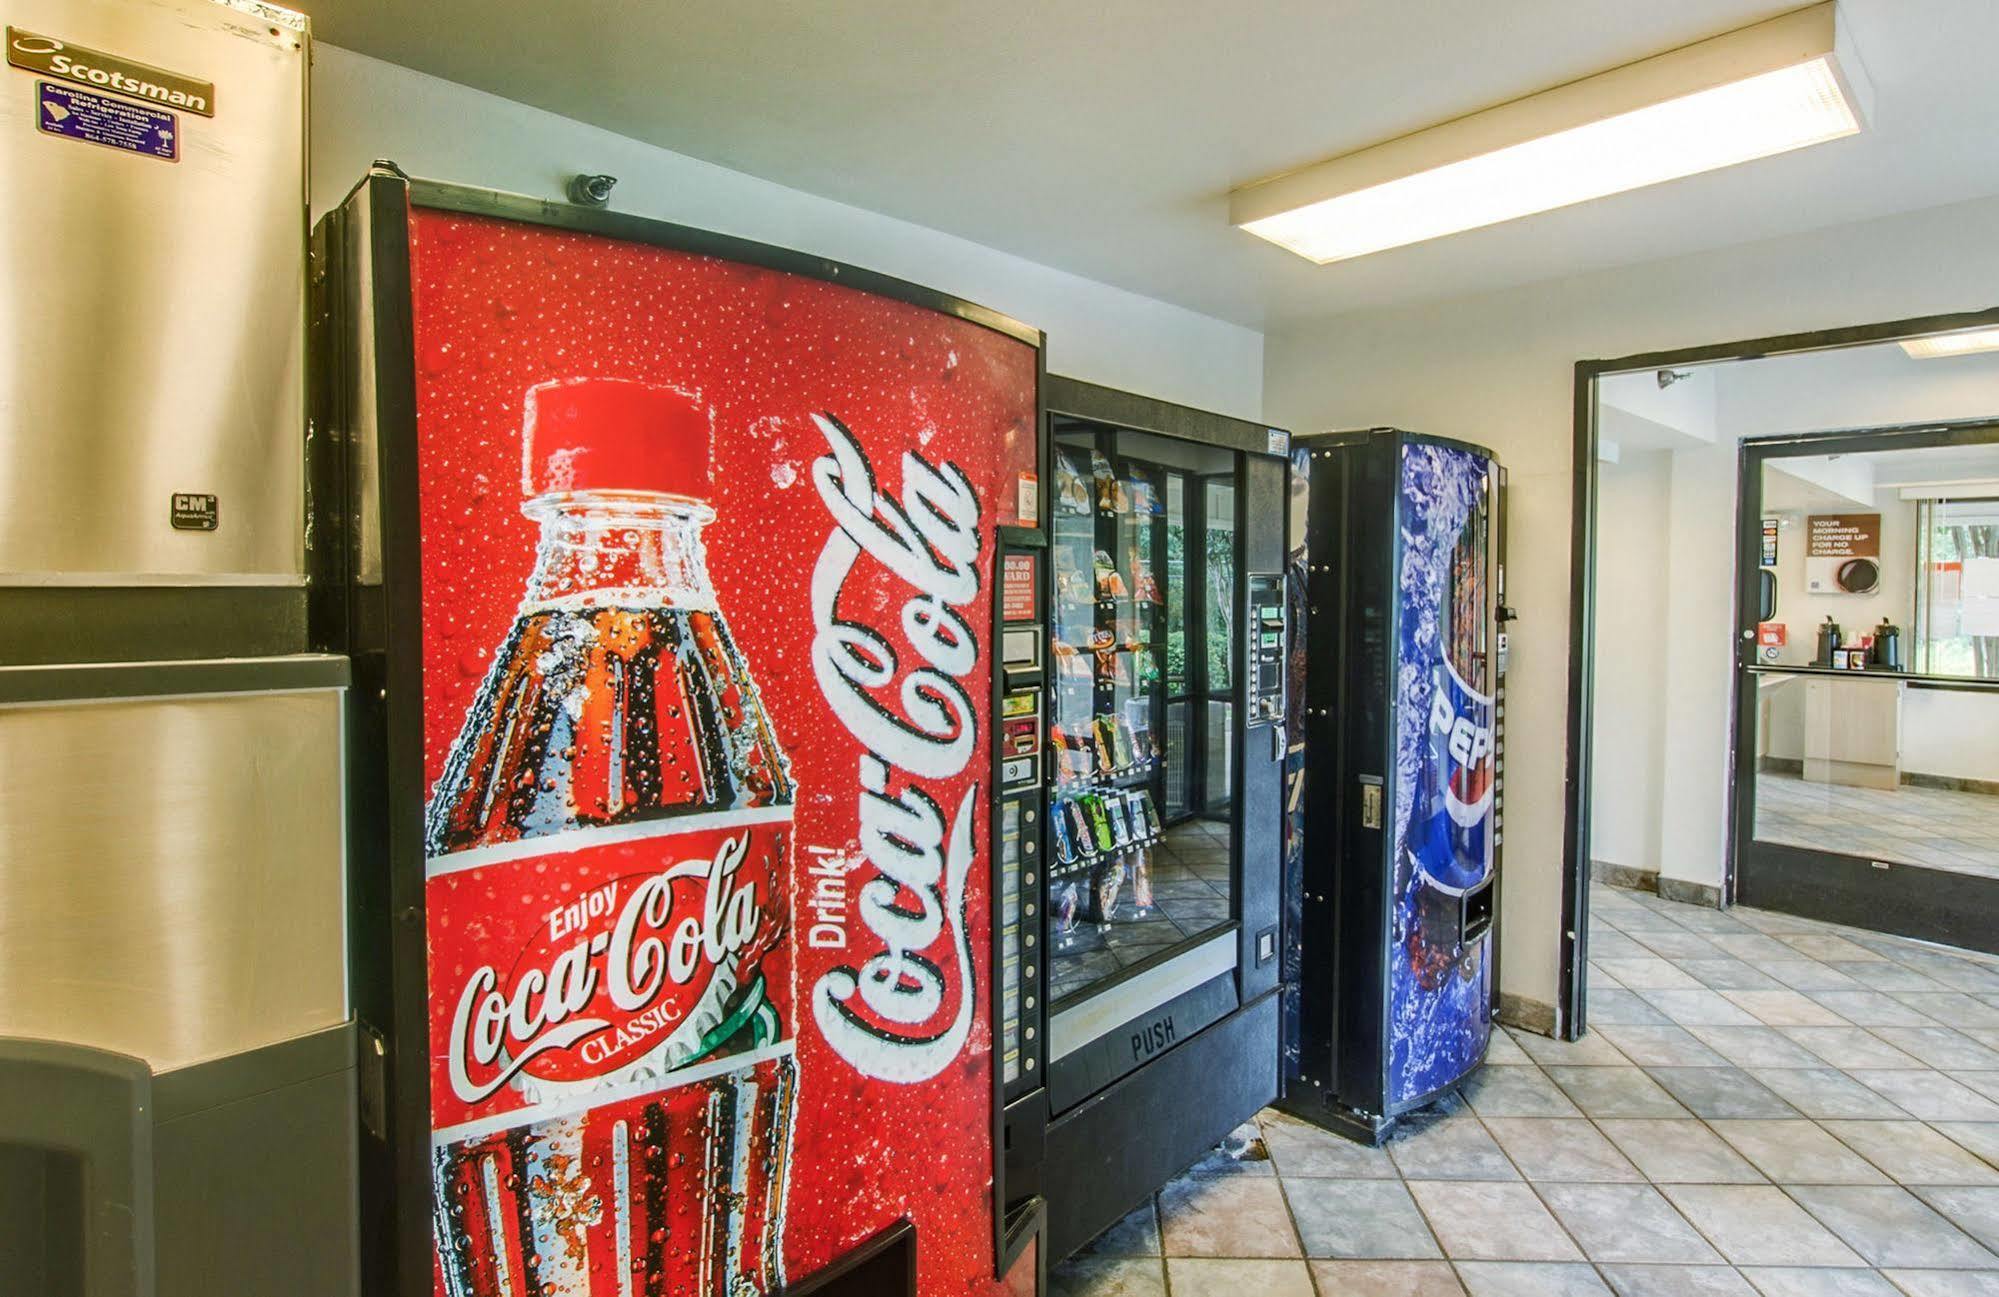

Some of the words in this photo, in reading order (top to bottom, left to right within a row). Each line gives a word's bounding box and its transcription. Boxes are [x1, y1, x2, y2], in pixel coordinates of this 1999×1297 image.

[45, 85, 98, 104] Carolina
[101, 99, 171, 123] Commercial
[49, 55, 206, 111] Scotsman
[70, 97, 149, 123] Refrigeration
[810, 410, 981, 1084] Coca-Cola
[548, 881, 619, 942] Enjoy
[808, 846, 848, 949] Drink!
[449, 829, 760, 1104] Coca-Cola
[580, 999, 682, 1065] CLASSIC
[1131, 1016, 1175, 1061] PUSH
